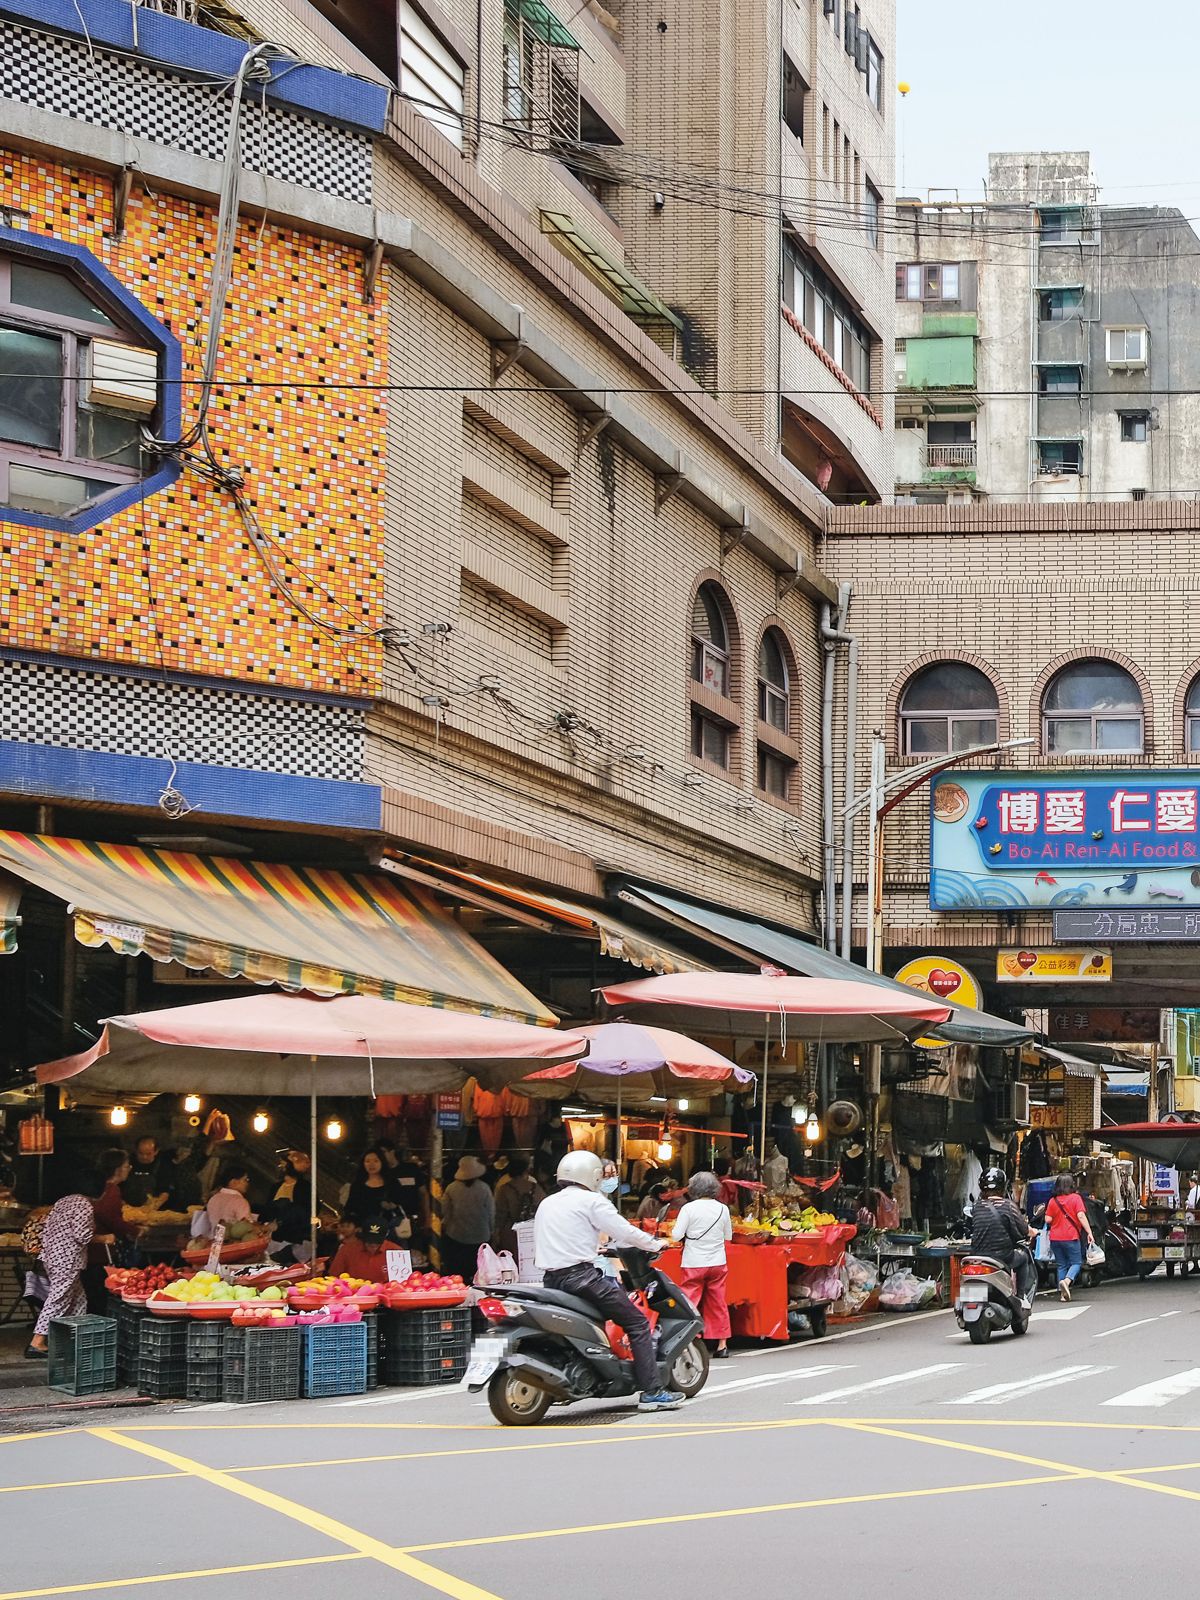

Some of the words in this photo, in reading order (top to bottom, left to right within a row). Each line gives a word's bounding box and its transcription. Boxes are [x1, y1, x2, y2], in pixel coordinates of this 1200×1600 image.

[998, 790, 1085, 834] 博愛
[1009, 842, 1059, 859] Bo-Ai
[1066, 842, 1127, 858] Ren-Ai
[1133, 841, 1178, 858] Food
[1182, 842, 1198, 857] &
[1038, 959, 1077, 970] 公益彩券
